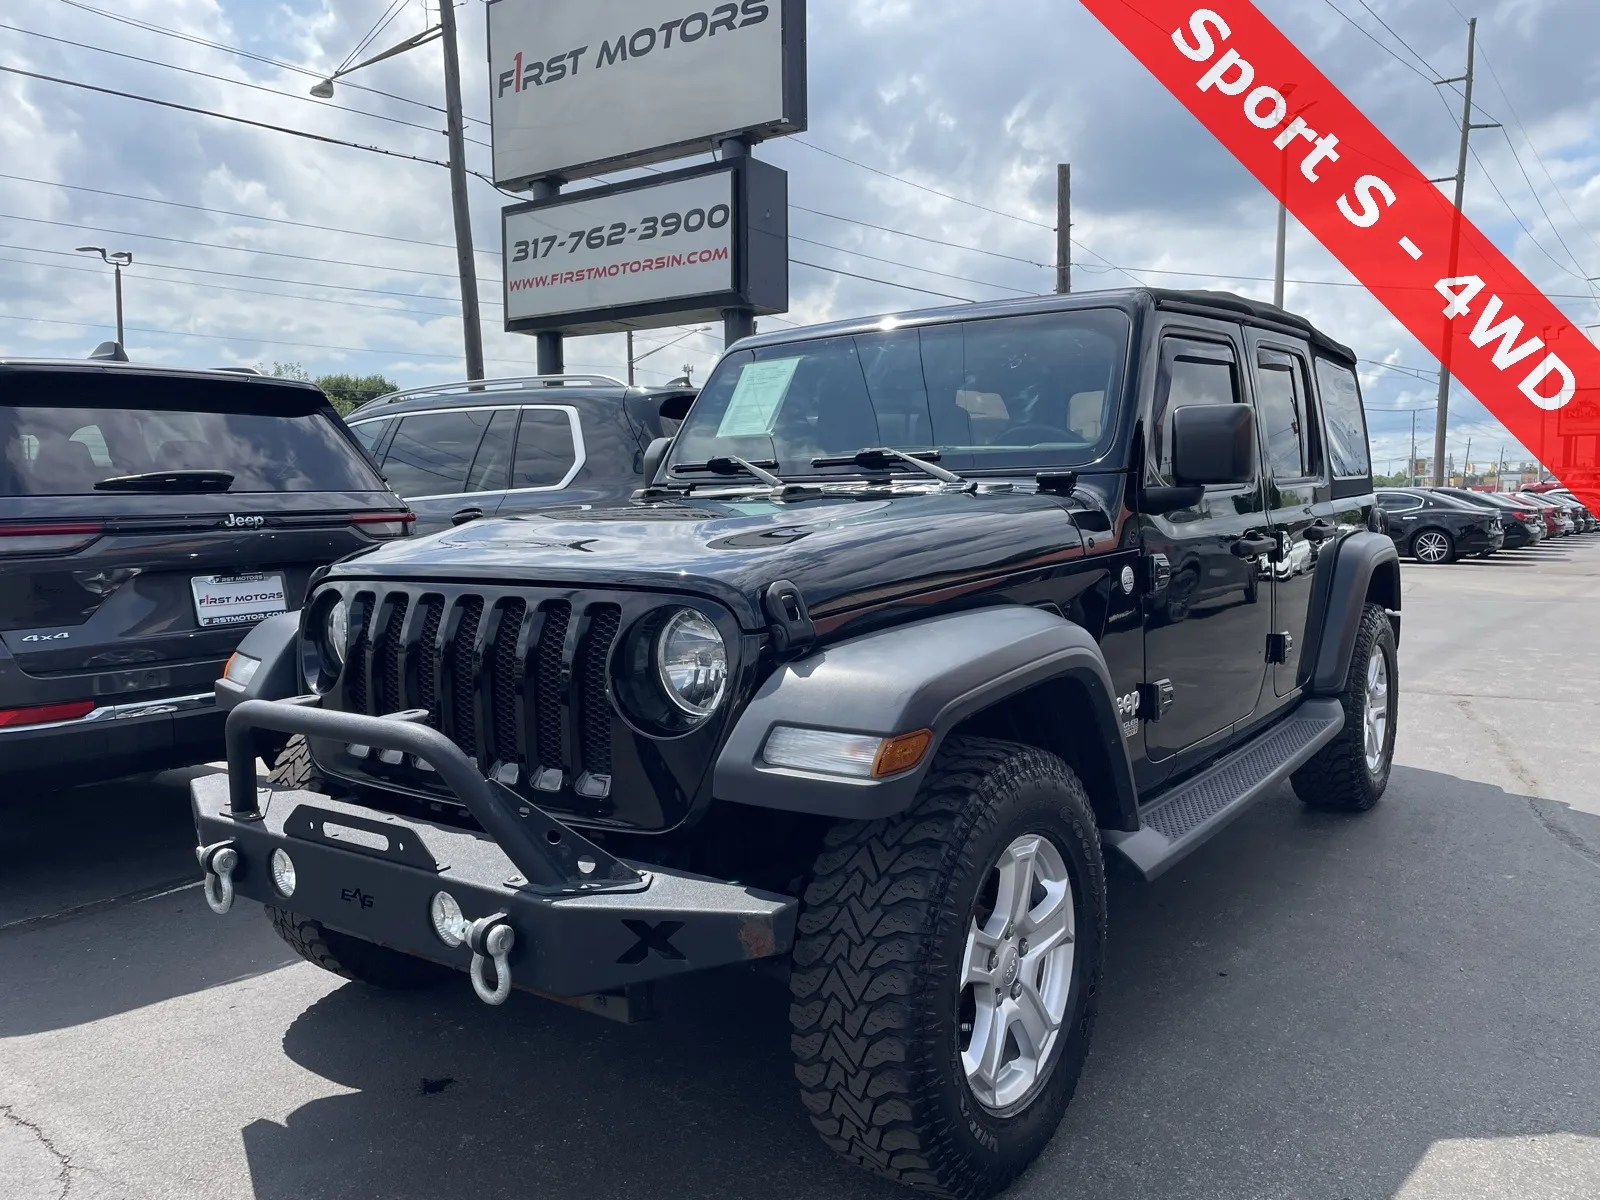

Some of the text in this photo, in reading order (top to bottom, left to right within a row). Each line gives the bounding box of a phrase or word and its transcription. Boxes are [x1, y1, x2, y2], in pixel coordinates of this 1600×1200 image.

[596, 0, 769, 69] MOTORS
[511, 204, 730, 262] 317-762-3900
[509, 247, 728, 292] WWW.FIRSTMOTORSIN.COM
[224, 513, 265, 529] Jeep
[235, 592, 284, 602] MOTORS
[22, 632, 69, 641] 4x4
[1116, 690, 1140, 716] eep
